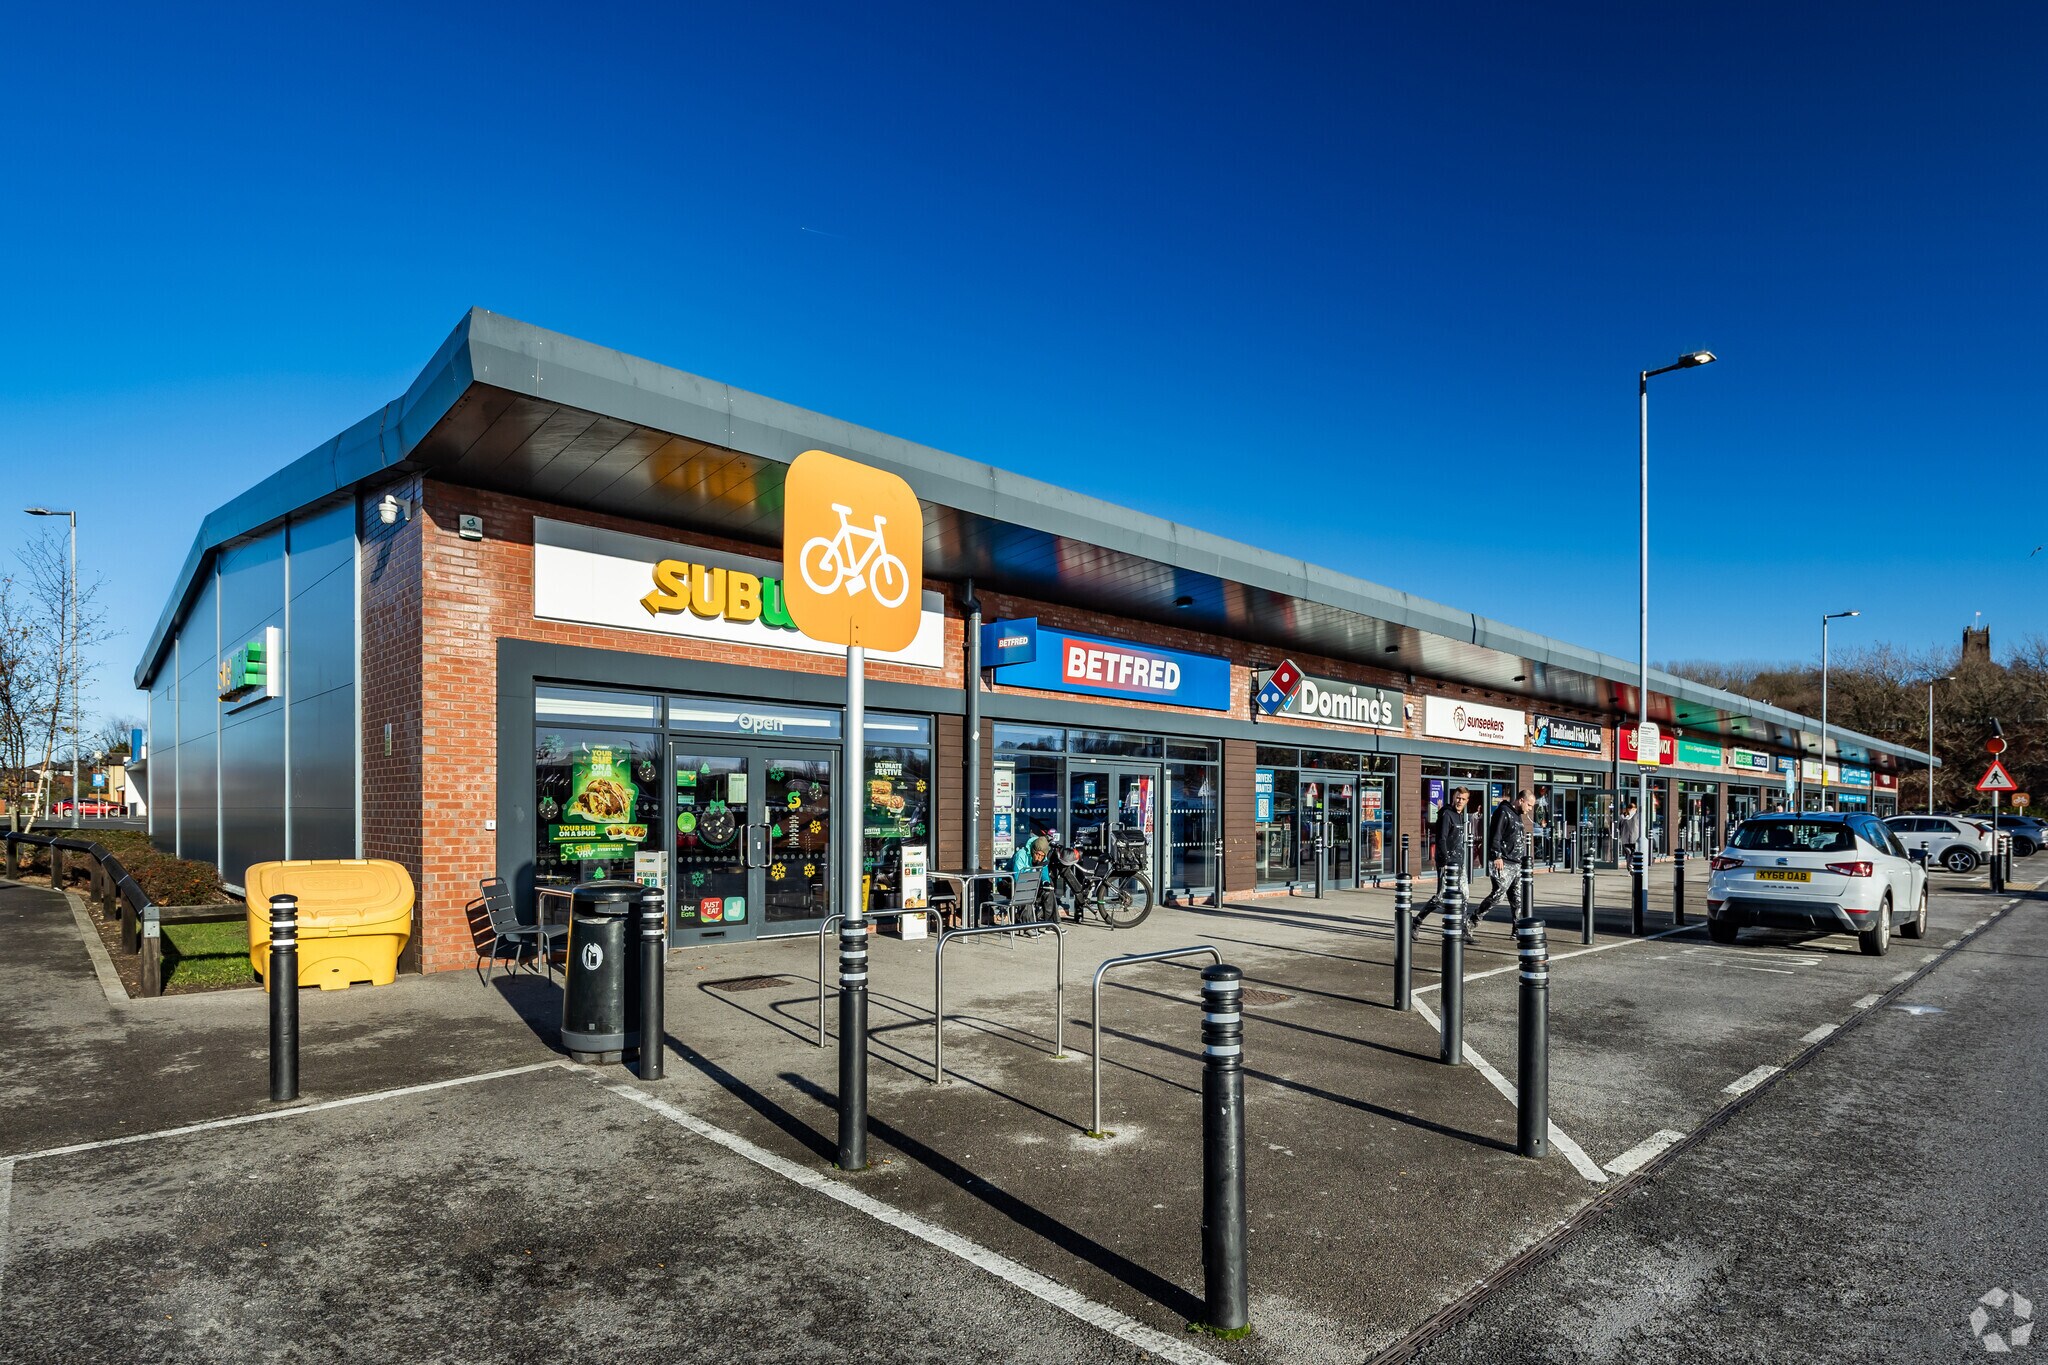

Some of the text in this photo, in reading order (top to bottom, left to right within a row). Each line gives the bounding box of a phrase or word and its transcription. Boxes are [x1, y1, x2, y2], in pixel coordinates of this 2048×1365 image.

[998, 637, 1028, 648] BETFRED
[1067, 646, 1181, 691] BETFRED
[1301, 680, 1392, 725] Domino's
[739, 713, 783, 734] Open
[1467, 716, 1504, 732] sunseekers
[704, 901, 719, 909] JUST
